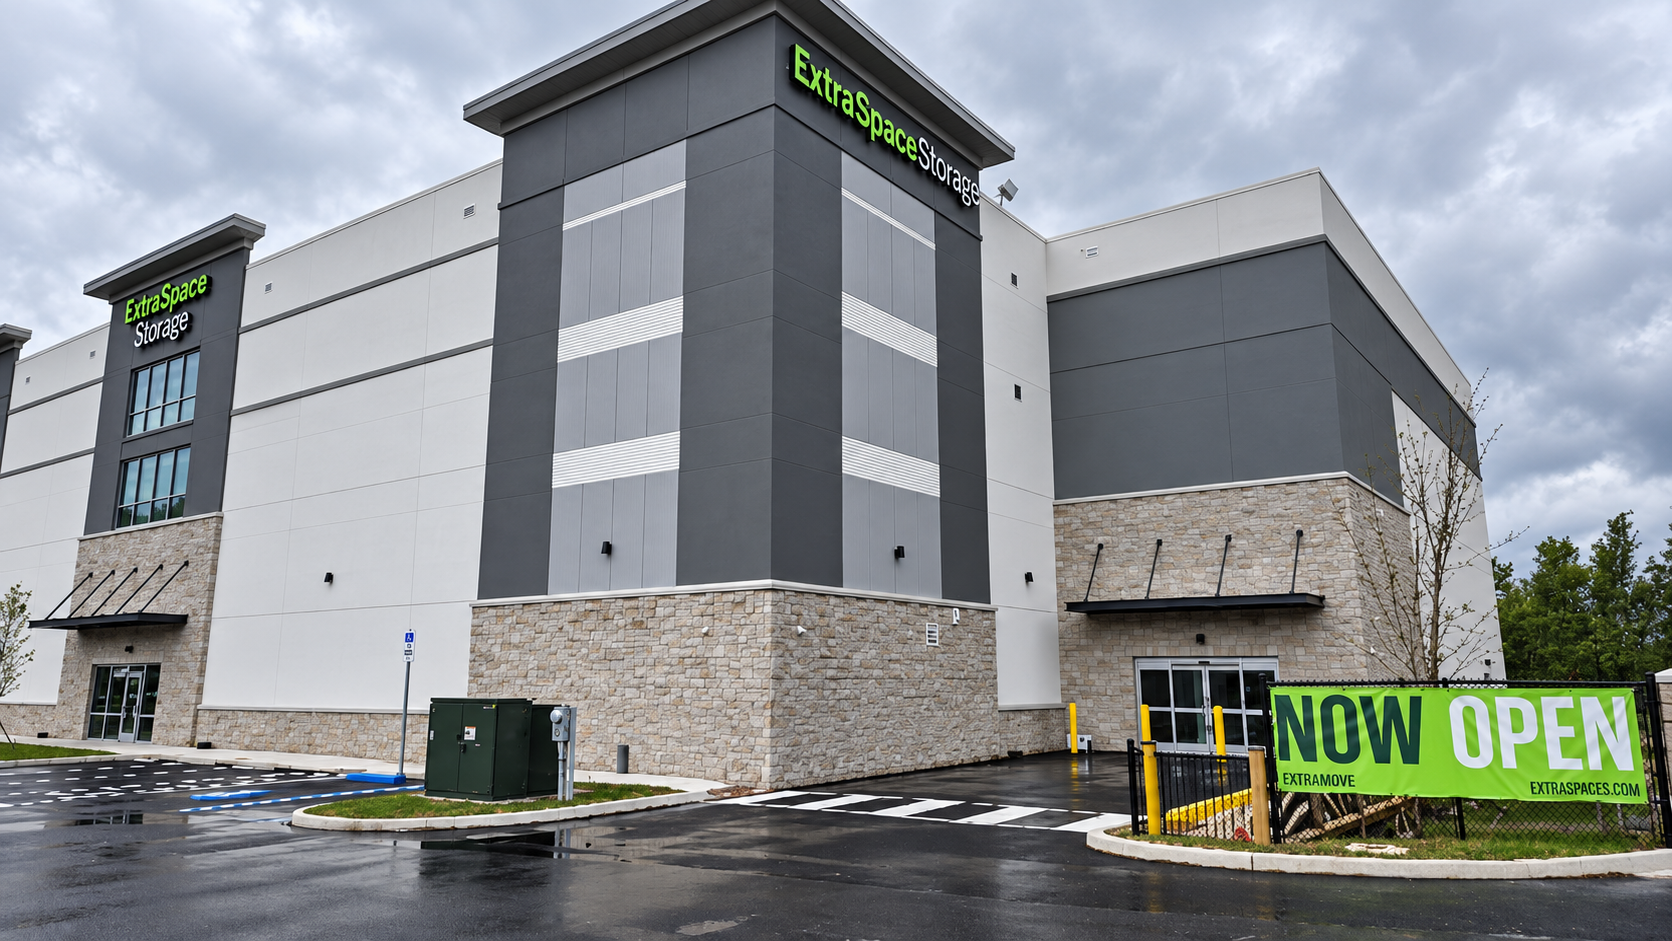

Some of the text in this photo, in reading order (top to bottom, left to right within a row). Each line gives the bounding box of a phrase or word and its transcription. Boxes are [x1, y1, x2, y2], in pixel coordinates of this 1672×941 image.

[125, 274, 207, 324] ExtraSpace
[134, 311, 189, 348] Storage
[1274, 694, 1635, 771] NOW OPEN
[1283, 772, 1356, 788] EXTRAMOVE
[1530, 781, 1641, 797] EXTRASPACES.COM
